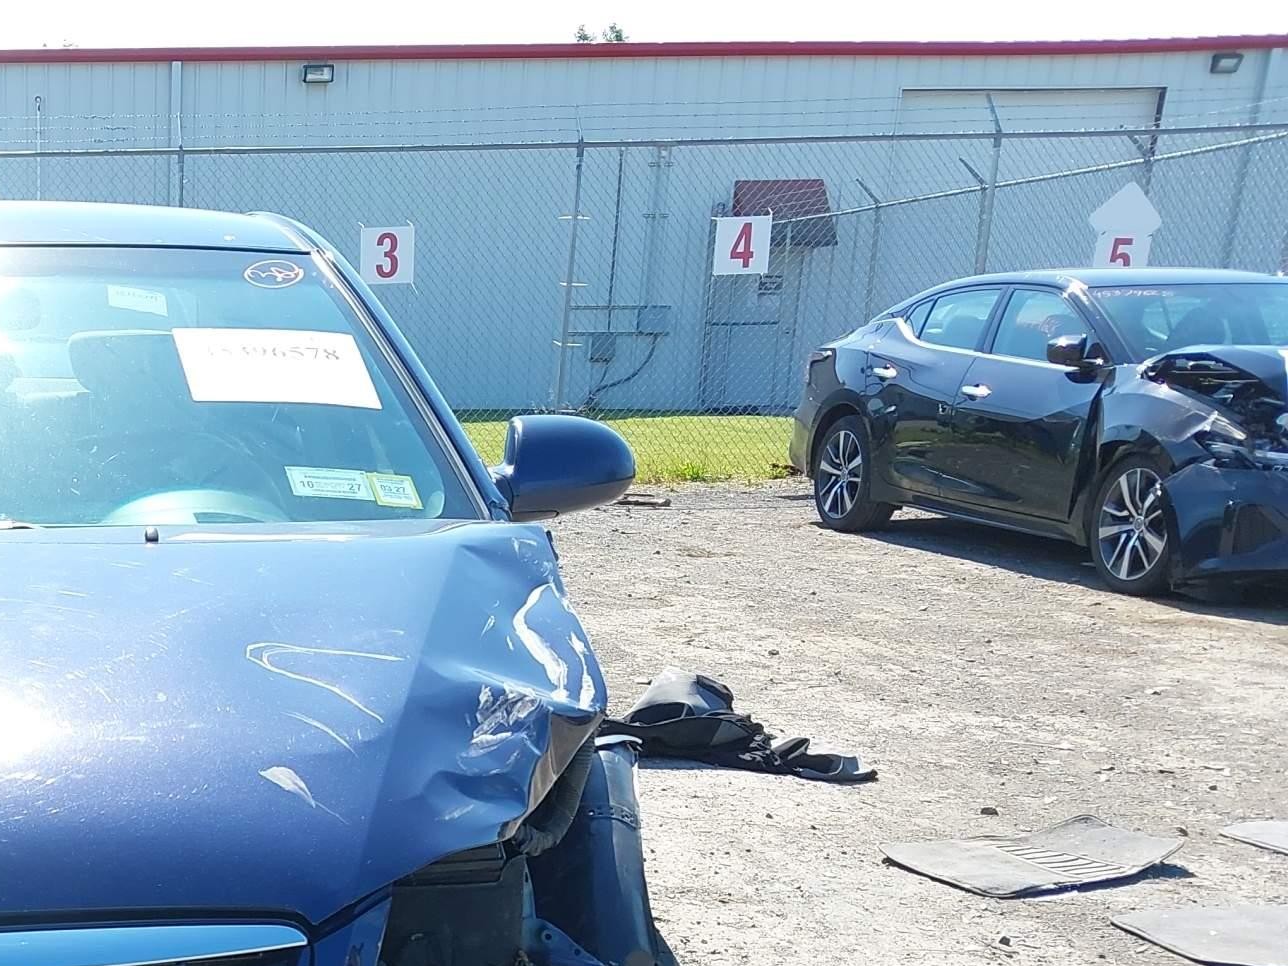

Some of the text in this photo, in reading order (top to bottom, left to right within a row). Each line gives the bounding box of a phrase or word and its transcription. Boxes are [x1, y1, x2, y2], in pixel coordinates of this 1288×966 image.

[376, 232, 399, 279] 3
[730, 222, 754, 268] 4
[1109, 238, 1133, 267] 5
[347, 483, 362, 492] 27
